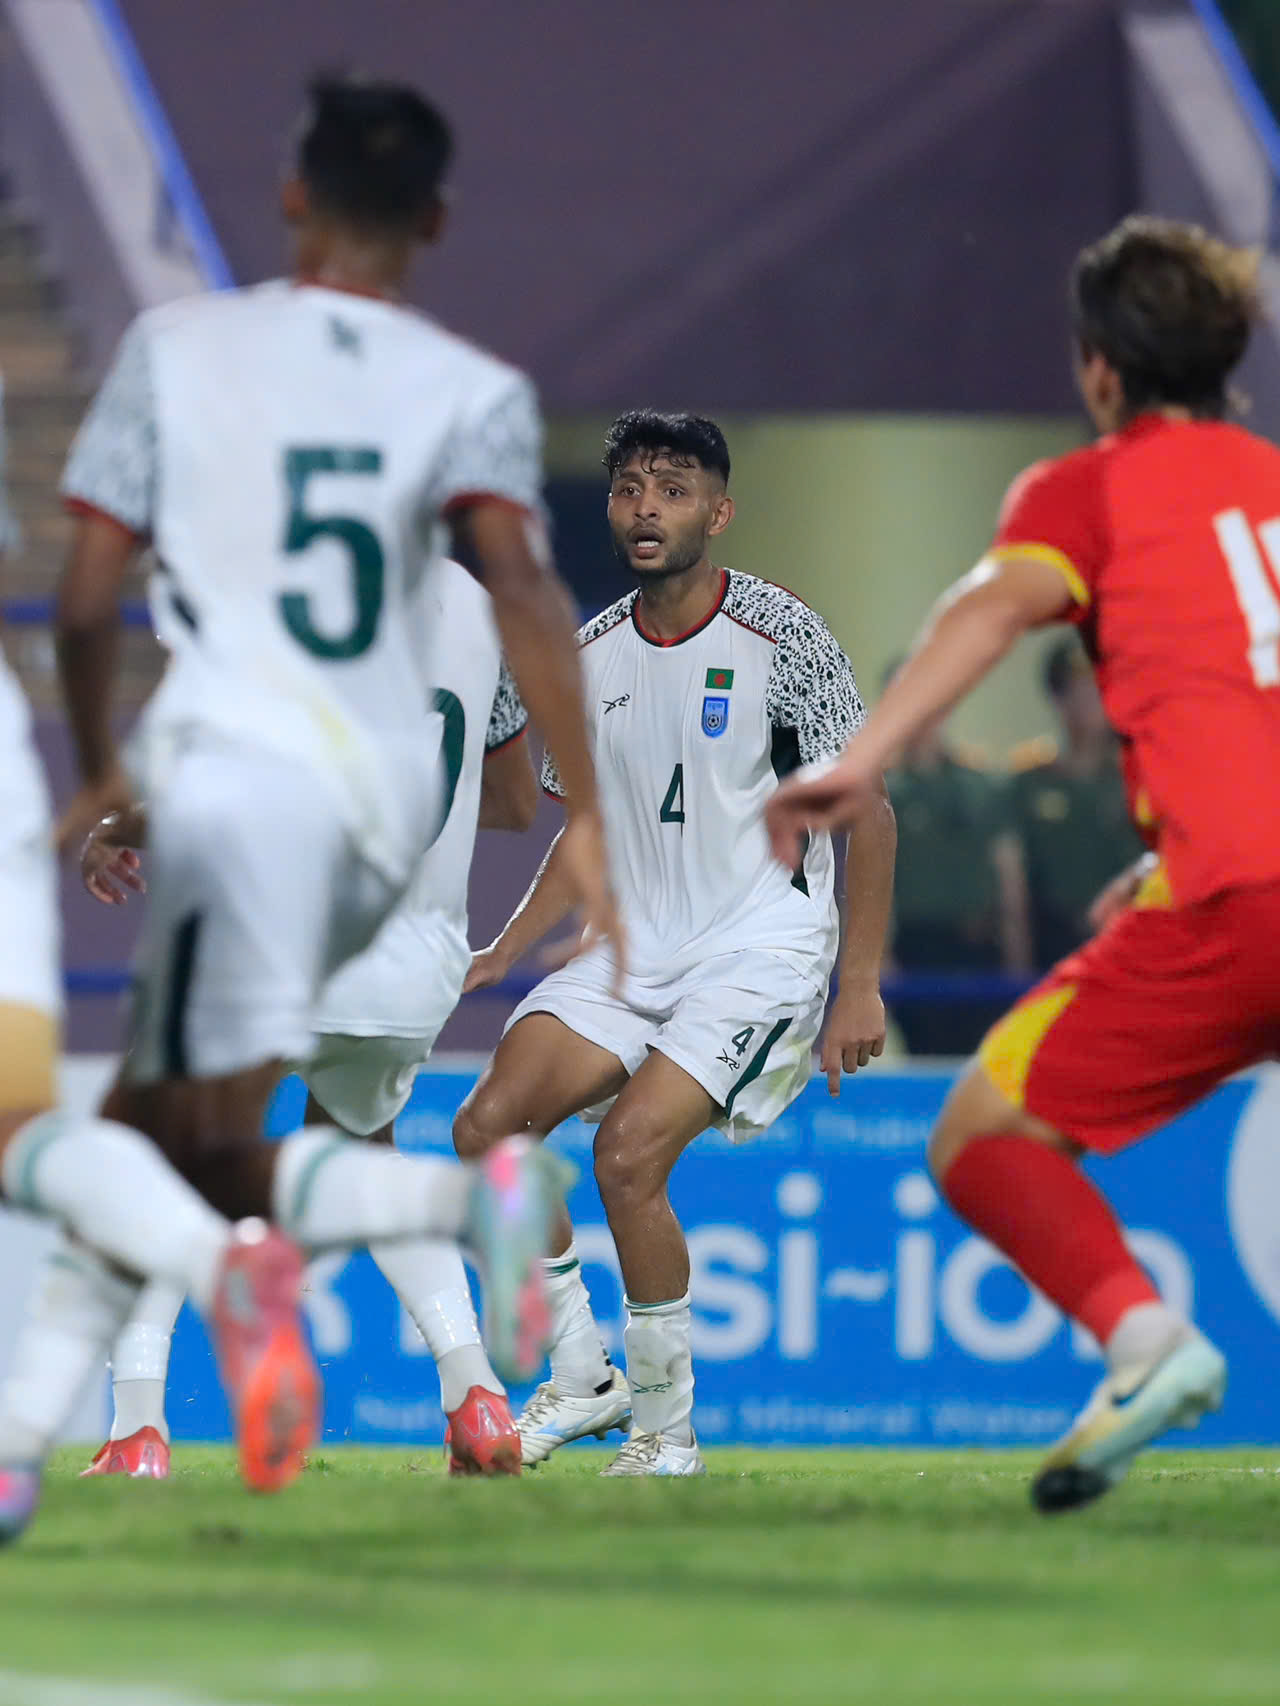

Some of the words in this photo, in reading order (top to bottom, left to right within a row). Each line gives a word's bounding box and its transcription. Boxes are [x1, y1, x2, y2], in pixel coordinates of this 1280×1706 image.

[279, 447, 386, 661] 5
[1212, 507, 1280, 688] 1
[660, 763, 685, 839] 4
[731, 1026, 755, 1057] 4
